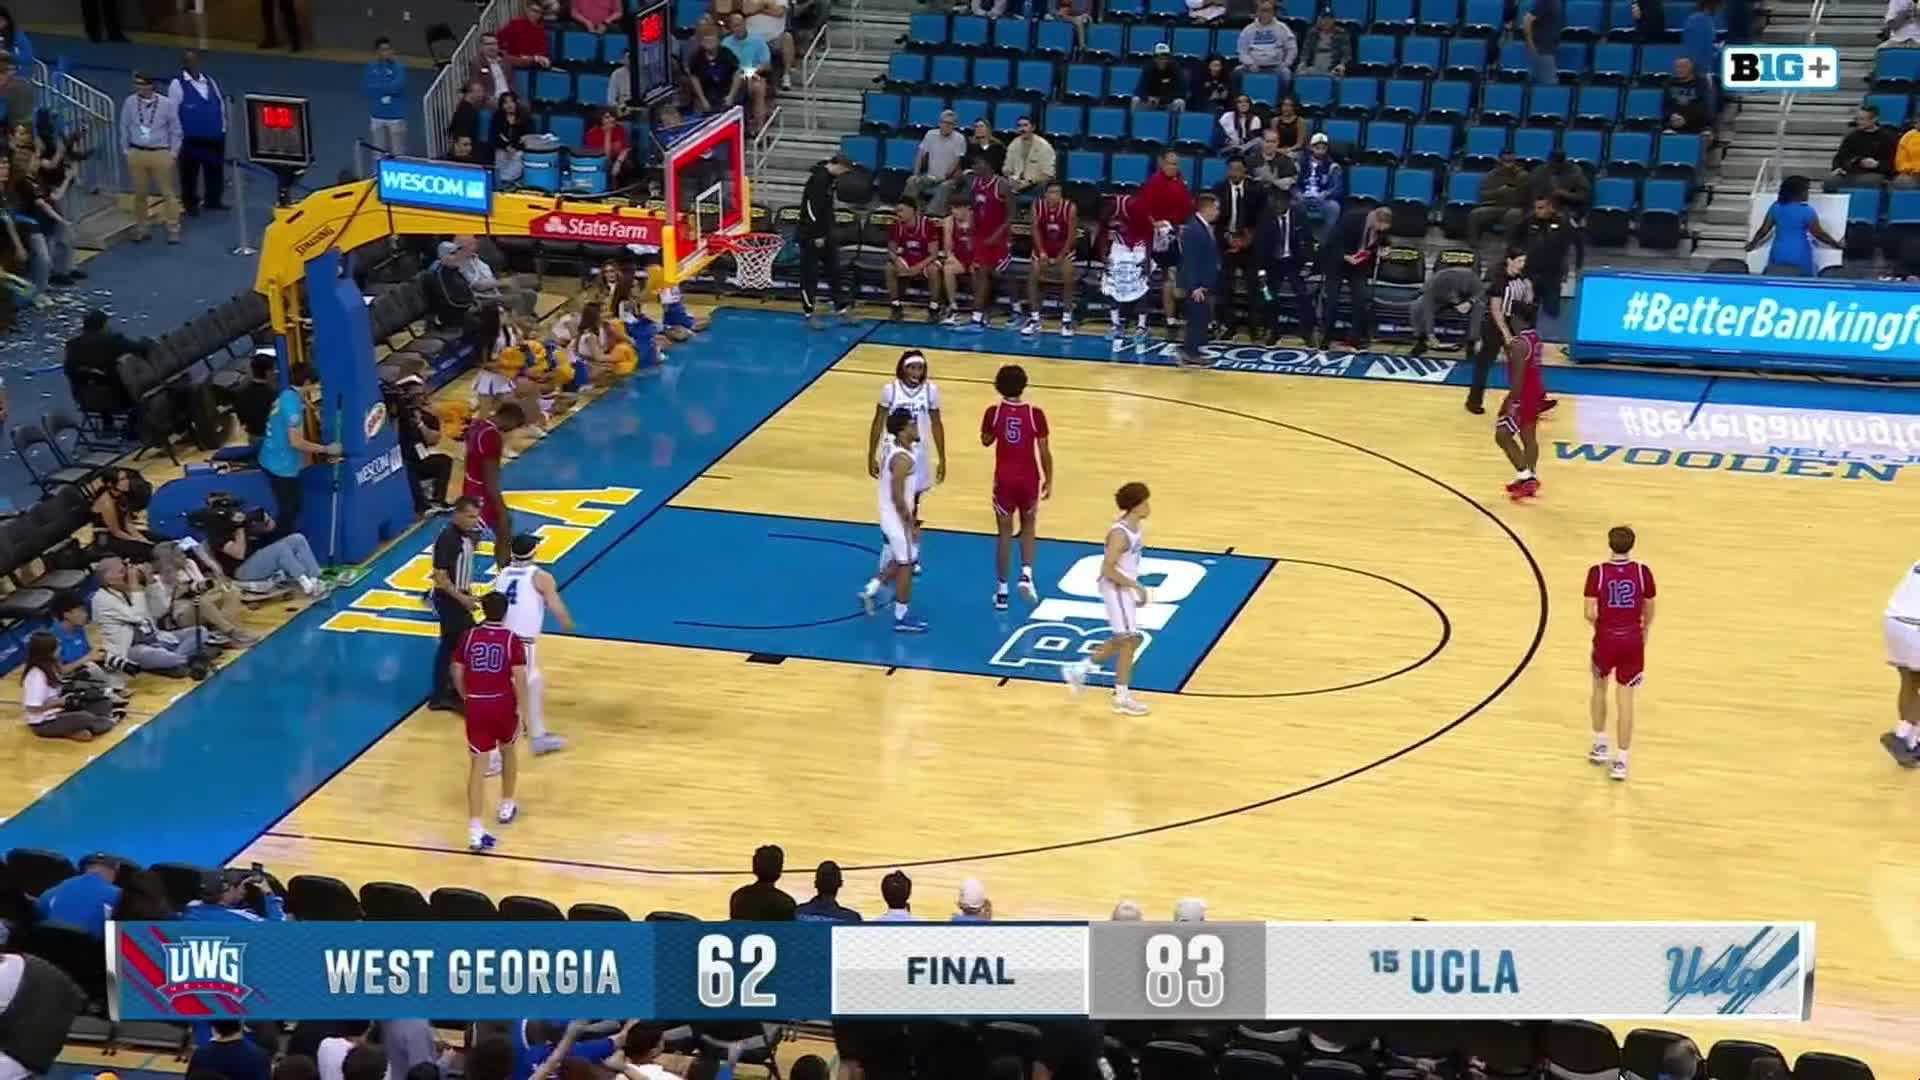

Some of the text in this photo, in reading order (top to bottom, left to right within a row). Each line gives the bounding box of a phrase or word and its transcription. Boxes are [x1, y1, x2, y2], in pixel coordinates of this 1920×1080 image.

[382, 171, 465, 197] WESCOM
[1622, 291, 1920, 351] #BetterBankingf
[1216, 359, 1347, 376] Financial
[1005, 416, 1022, 443] 5
[1552, 441, 1904, 482] WOODEN
[1768, 446, 1864, 460] NELL
[506, 579, 518, 604] 4
[1608, 580, 1636, 608] 12
[471, 642, 504, 673] 20
